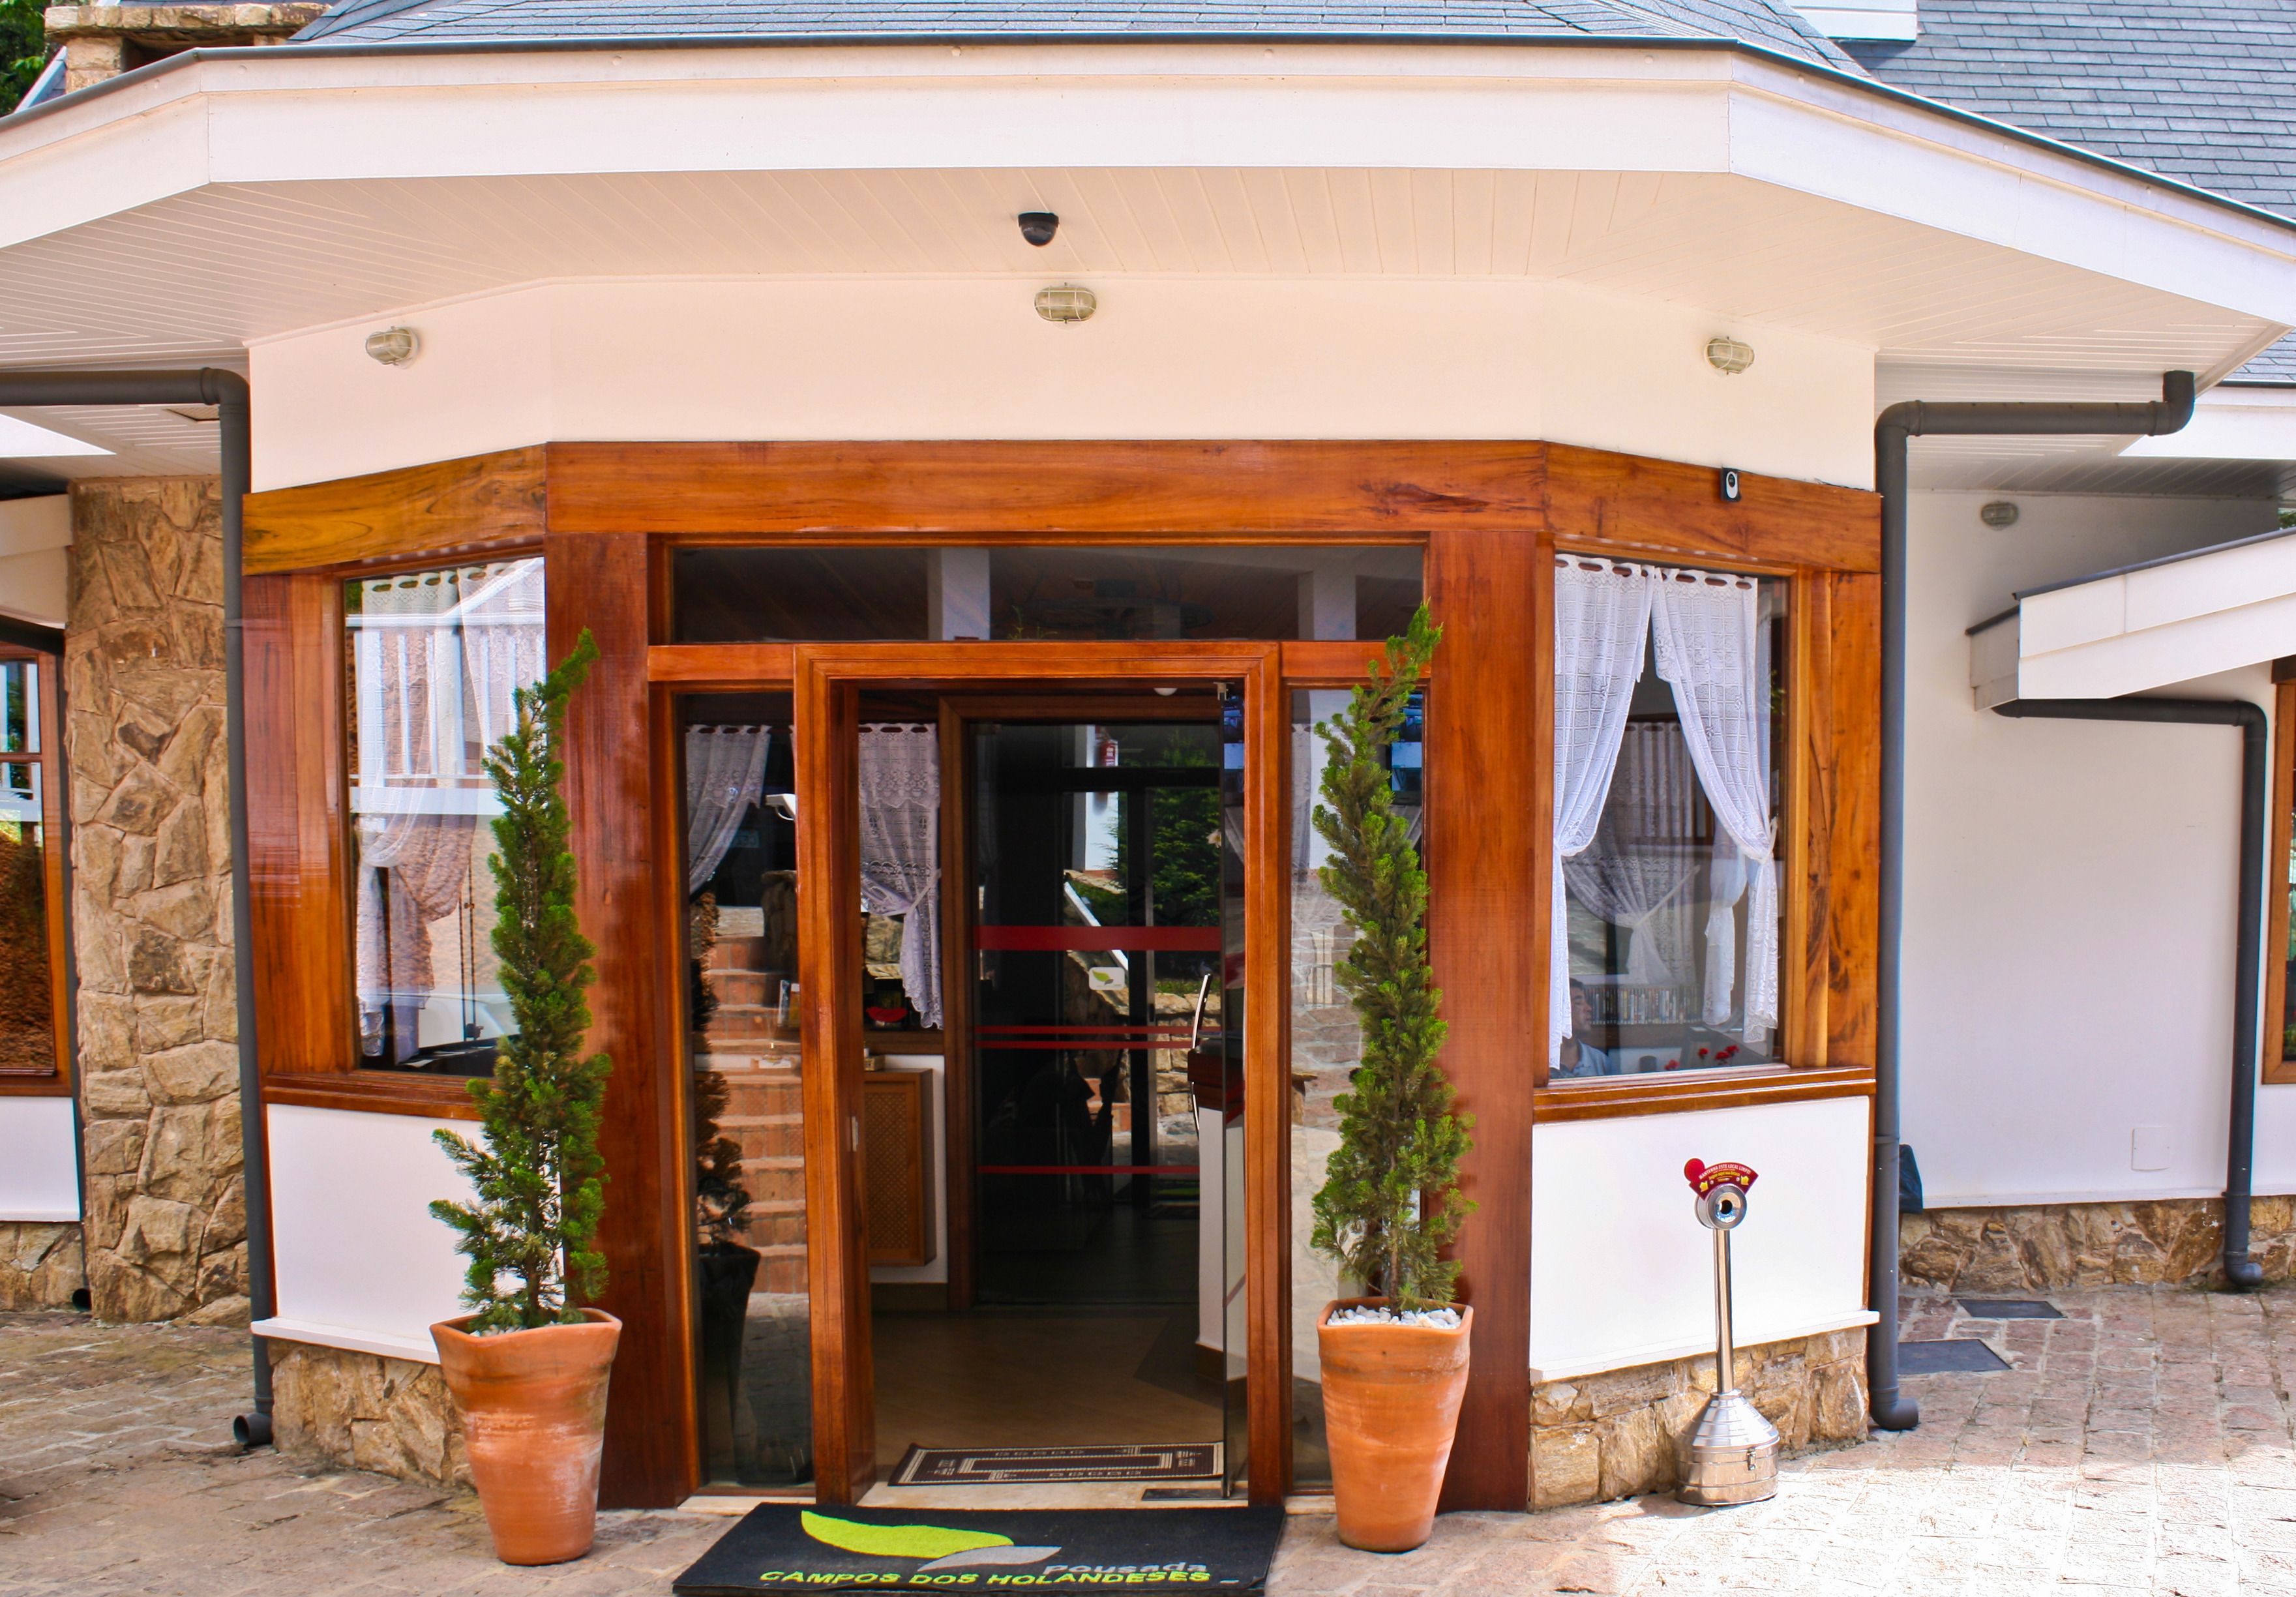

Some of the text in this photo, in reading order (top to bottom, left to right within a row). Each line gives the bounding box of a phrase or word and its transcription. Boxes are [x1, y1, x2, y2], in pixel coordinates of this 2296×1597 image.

[760, 1571, 1211, 1585] CAMPOS DOS HOLANDESES
